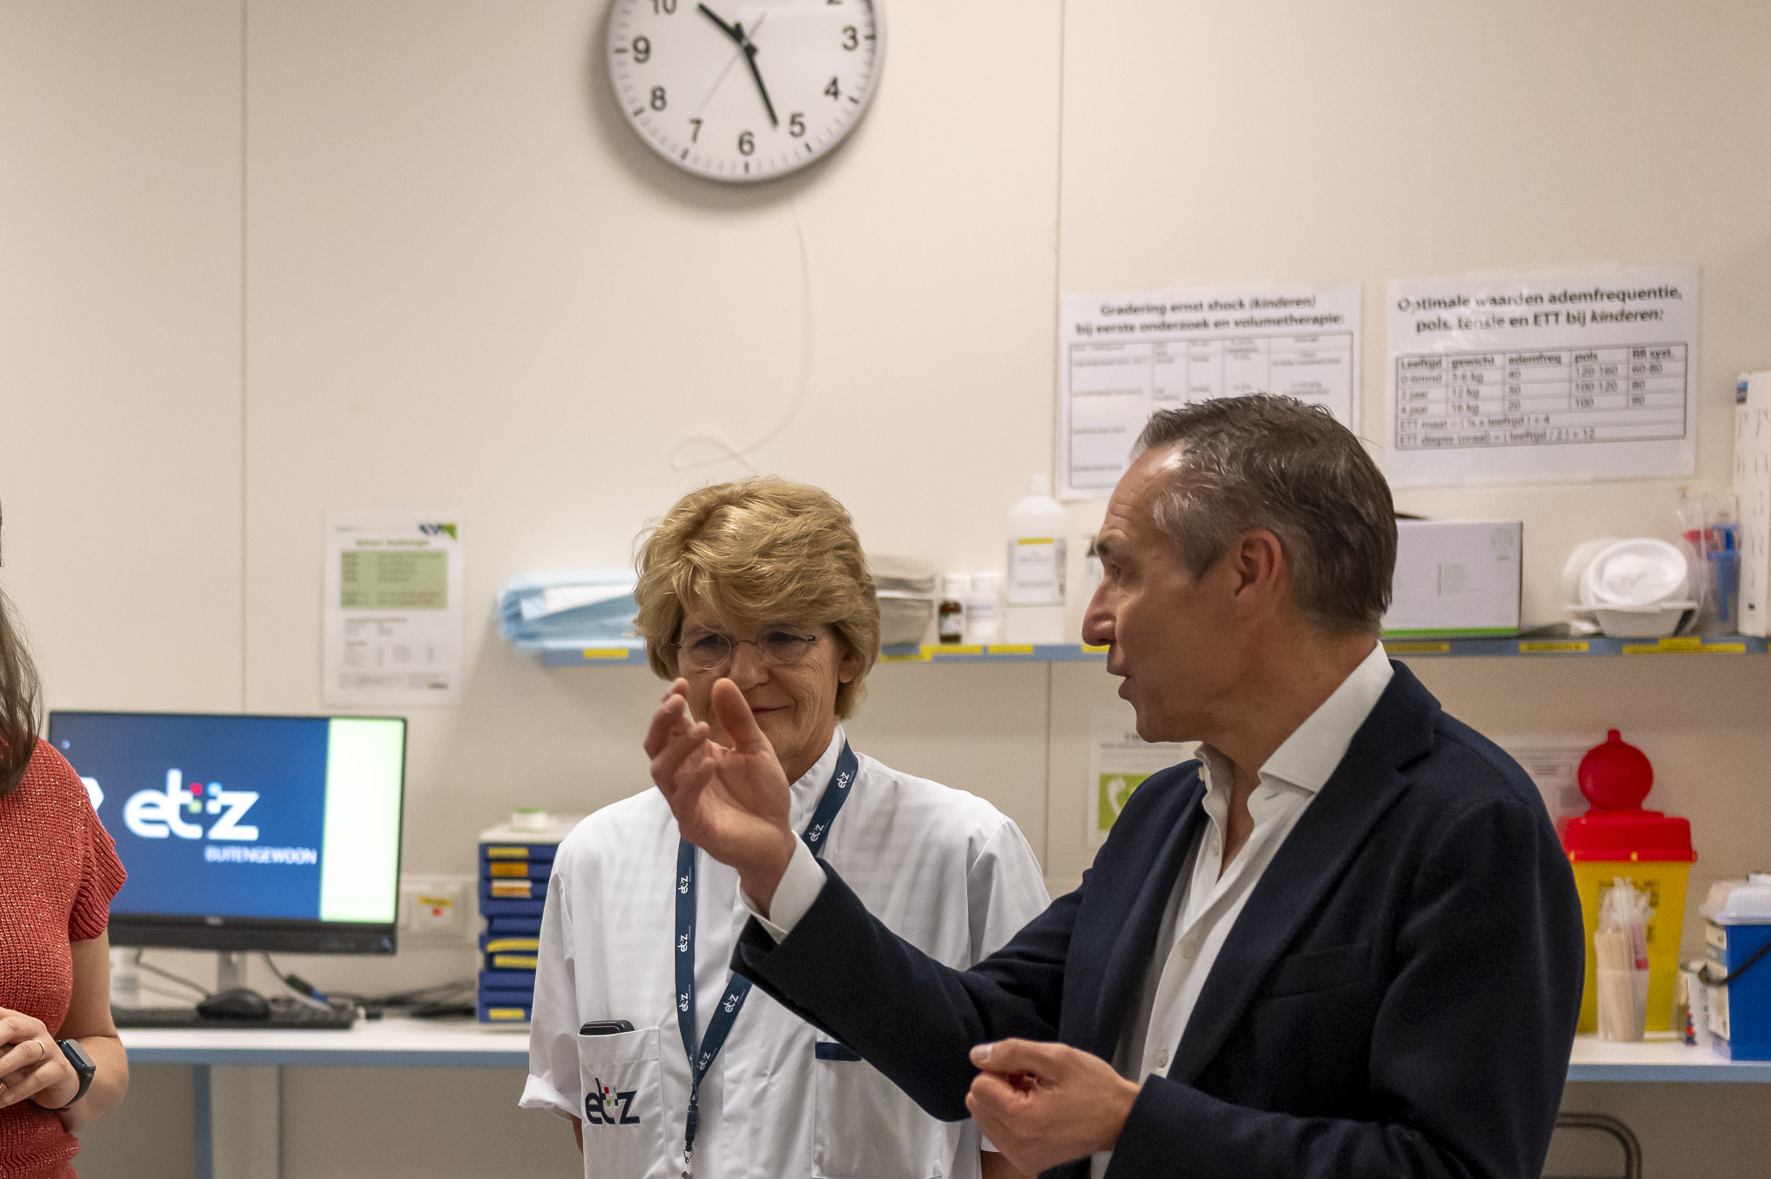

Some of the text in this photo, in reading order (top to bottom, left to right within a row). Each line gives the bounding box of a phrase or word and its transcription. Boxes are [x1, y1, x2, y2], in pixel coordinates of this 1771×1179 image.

[632, 36, 652, 65] 9
[841, 25, 860, 52] 3
[649, 85, 668, 112] 8
[823, 75, 842, 101] 4
[687, 118, 704, 145] 7
[788, 112, 807, 139] 5
[736, 130, 756, 157] 6
[1100, 294, 1317, 317] Gradering ernst shock (kinderen)
[1076, 321, 1093, 338] bij
[1096, 323, 1136, 334] eerste
[1139, 318, 1209, 333] onderzoek
[1214, 319, 1230, 329] en
[1509, 316, 1529, 330] en
[1533, 311, 1562, 328] ETT
[1566, 309, 1587, 328] bij
[1575, 350, 1598, 364] pols
[123, 768, 260, 842] etz
[585, 1077, 641, 1125] etz
